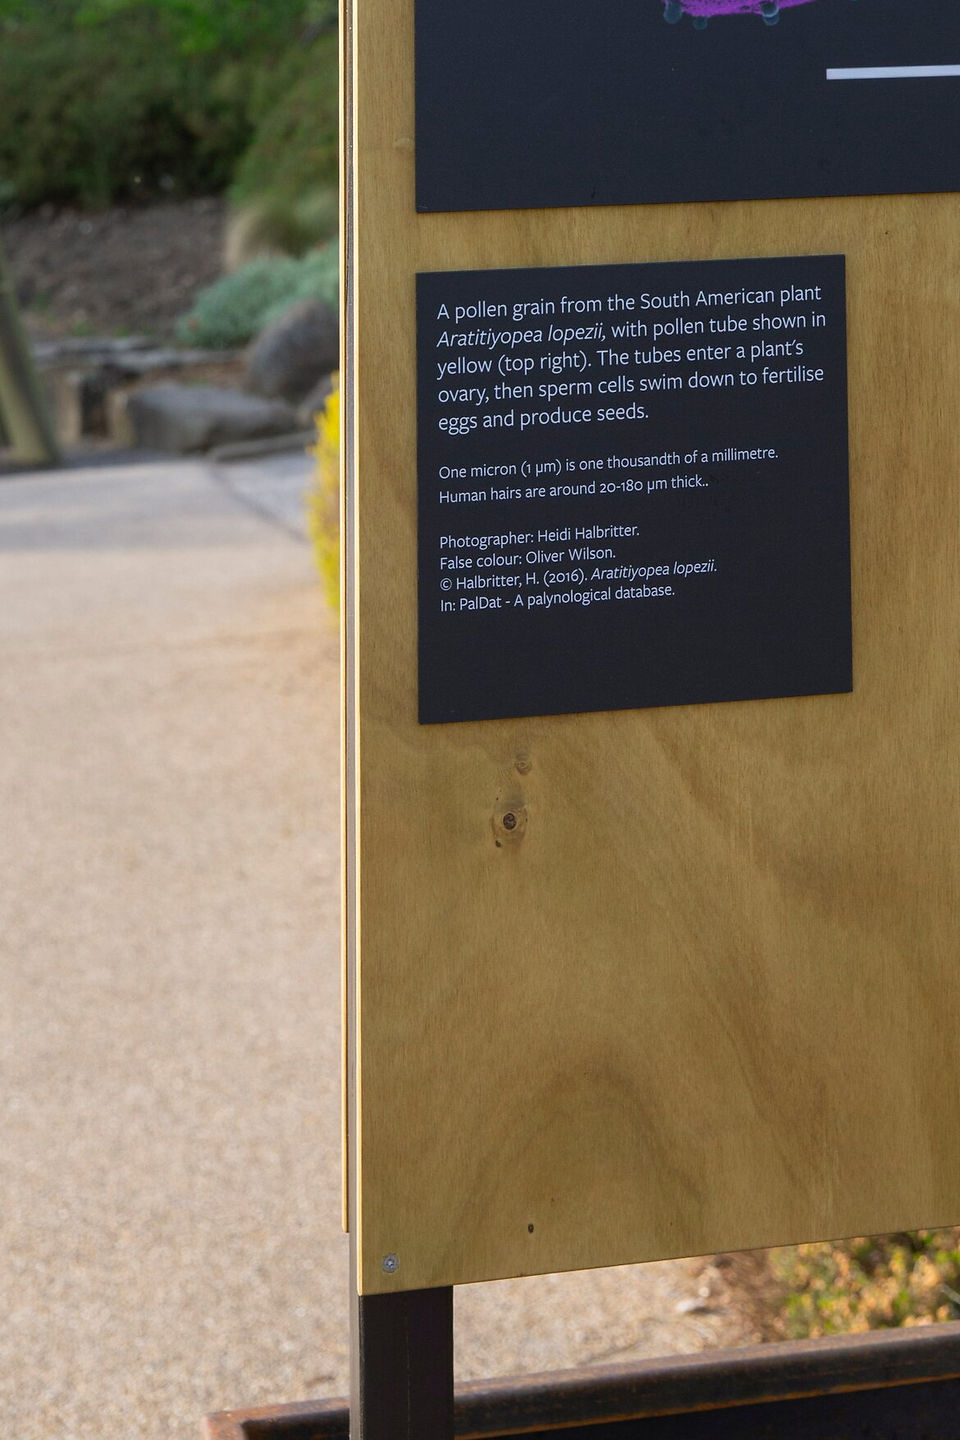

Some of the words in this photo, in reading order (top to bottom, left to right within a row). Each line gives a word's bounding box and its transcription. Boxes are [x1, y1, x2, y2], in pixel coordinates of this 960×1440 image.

[437, 304, 449, 319] A
[456, 301, 507, 324] pollen
[513, 299, 554, 321] grain
[560, 296, 601, 313] from
[607, 294, 634, 311] the
[641, 291, 689, 309] South
[696, 288, 774, 306] American
[781, 285, 821, 306] plant
[437, 329, 542, 349] Aratitiyopea
[548, 323, 605, 345] lopezii,
[611, 320, 647, 337] with
[654, 318, 703, 340] pollen
[709, 315, 747, 332] tube
[753, 313, 806, 330] shown
[812, 311, 825, 327] in
[437, 357, 492, 380] yellow
[498, 355, 534, 376] (top
[541, 350, 591, 374] right).
[597, 349, 629, 366] The
[634, 346, 681, 364] tubes
[687, 346, 731, 361] enter
[736, 346, 745, 358] a
[438, 388, 489, 406] ovary,
[494, 382, 533, 399] then
[539, 382, 592, 401] sperm
[598, 376, 634, 393] cells
[640, 374, 682, 391] swim
[688, 371, 734, 388] down
[739, 371, 757, 385] to
[762, 365, 823, 383] fertilise
[439, 416, 477, 435] eggs
[483, 409, 513, 427] and
[521, 407, 591, 430] produce
[597, 402, 648, 421] seeds.
[439, 467, 466, 479] One
[471, 464, 516, 477] micron
[521, 461, 530, 477] (1
[566, 459, 575, 471] is
[579, 460, 603, 470] one
[607, 452, 680, 468] thousandth
[684, 450, 697, 463] of
[701, 453, 708, 462] a
[712, 448, 778, 461] millimetre.
[440, 491, 486, 503] Human
[491, 487, 521, 500] hairs
[526, 488, 545, 498] are
[550, 481, 595, 496] around
[600, 479, 643, 493] 20-180
[671, 474, 708, 488] thick..
[440, 531, 533, 550] Photographer:
[538, 528, 570, 542] Heidi
[576, 525, 639, 539] Halbritter.
[441, 556, 472, 570] False
[477, 553, 521, 567] colour:
[526, 550, 564, 563] Oliver
[569, 547, 615, 560] Wilson.
[457, 575, 522, 589] Halbritter,
[526, 572, 539, 584] H.
[544, 568, 587, 587] (2016).
[591, 565, 669, 581] Aratitiyopea
[674, 559, 716, 577] lopezii.
[441, 600, 455, 611] In:
[460, 596, 501, 610] PalDat
[514, 594, 523, 606] A
[528, 587, 610, 609] palynological
[615, 584, 674, 599] database.
